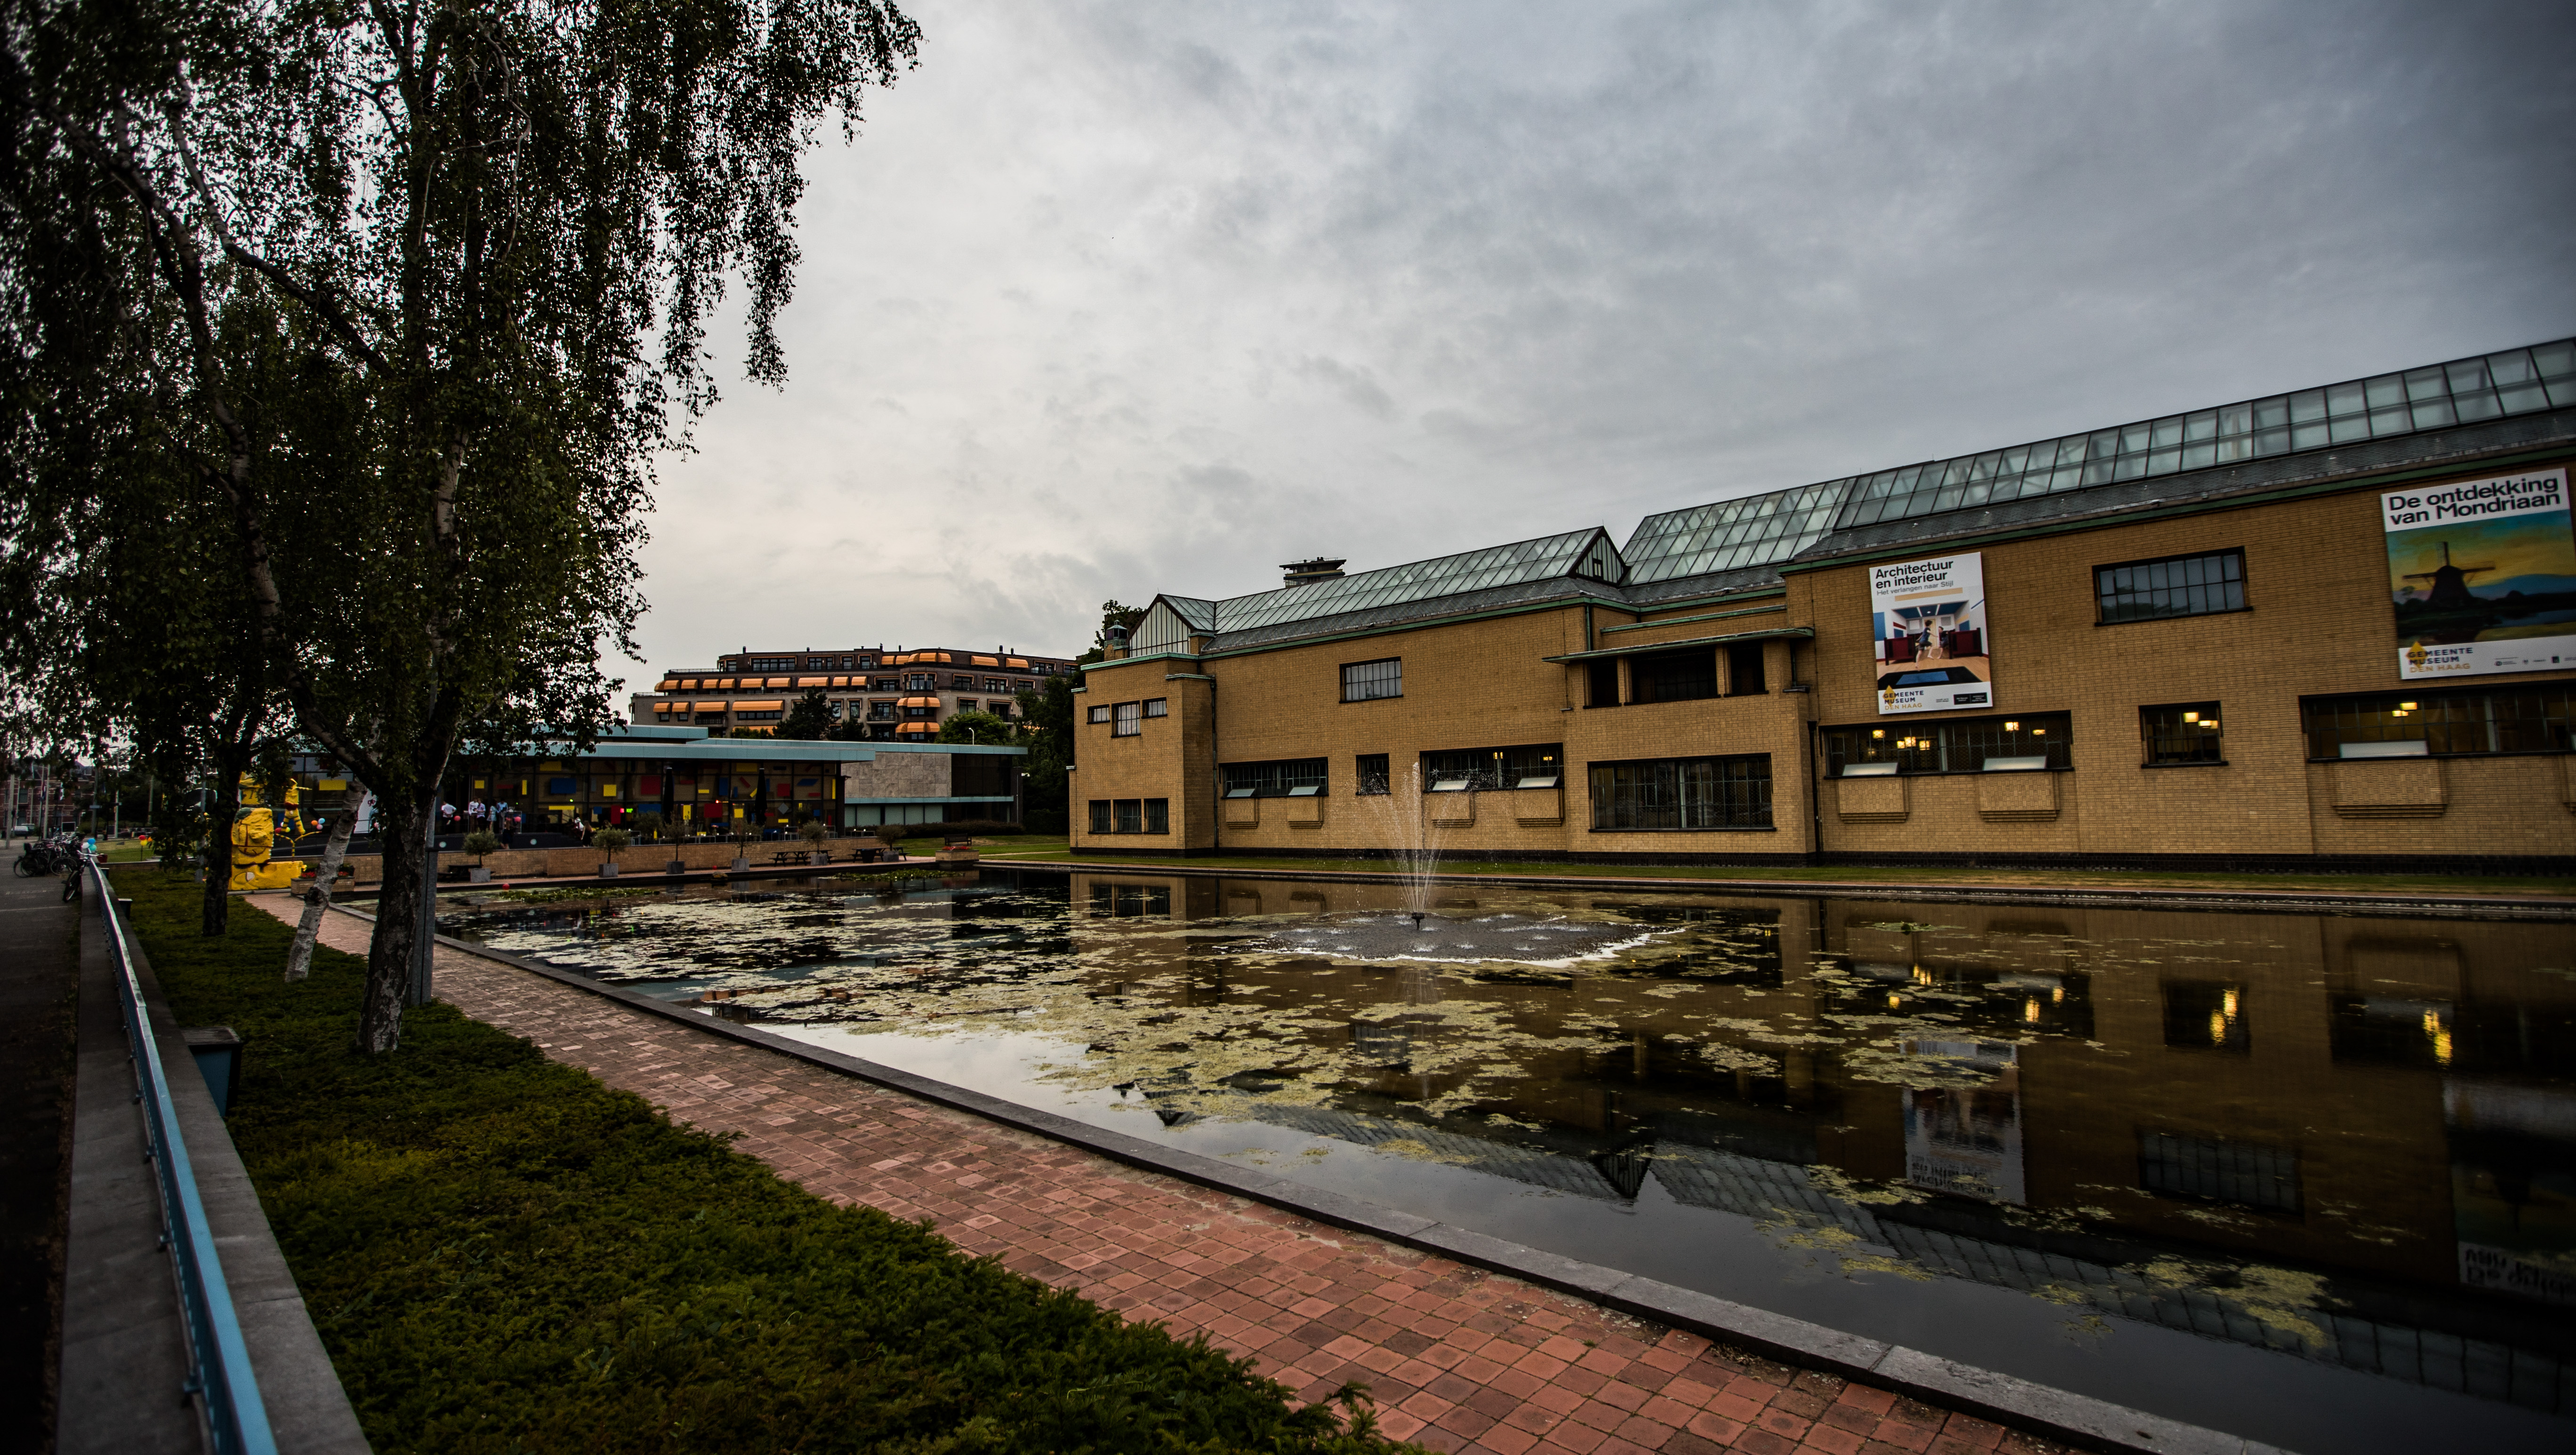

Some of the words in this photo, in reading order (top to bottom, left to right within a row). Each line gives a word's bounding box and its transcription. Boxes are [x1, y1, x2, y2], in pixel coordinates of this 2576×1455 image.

[2389, 496, 2421, 511] De
[2427, 478, 2559, 506] ontdekking
[2390, 510, 2430, 525] van
[2436, 493, 2561, 519] Mondriaan
[1876, 561, 1954, 579] Architectuur
[1876, 580, 1891, 588] en
[1894, 572, 1948, 586] interieur
[1891, 586, 1922, 594] verlangen
[2408, 647, 2473, 658] GEMEENTE
[2409, 656, 2460, 665] MUSEUM
[2437, 663, 2471, 671] HAAG
[1884, 691, 1924, 699] GEMEENTE
